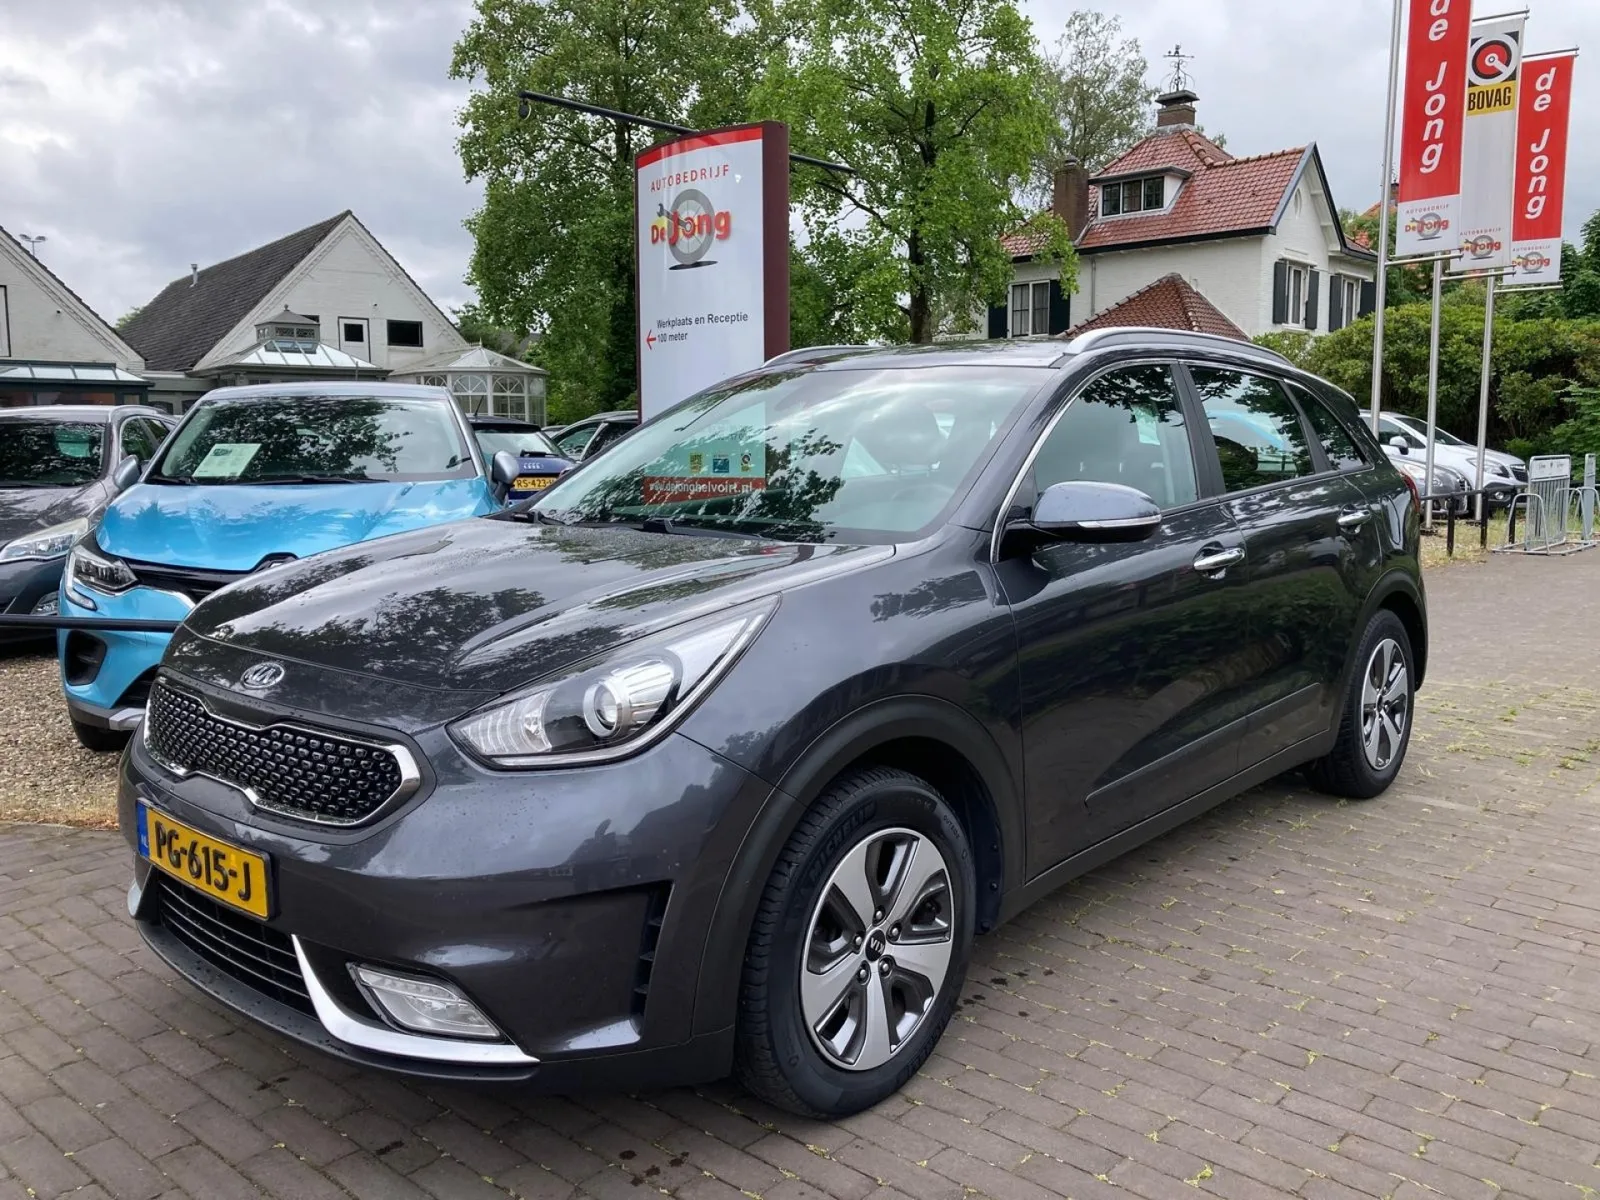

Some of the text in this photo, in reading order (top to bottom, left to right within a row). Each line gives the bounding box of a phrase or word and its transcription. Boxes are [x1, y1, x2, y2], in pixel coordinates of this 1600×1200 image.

[1467, 86, 1512, 111] BOVAG
[1420, 61, 1448, 174] Jong
[1525, 67, 1556, 220] de Jong
[651, 165, 729, 192] AUTOBEDRIJF
[651, 210, 731, 246] De Jong
[656, 312, 749, 329] Werkplaats en Receptie
[657, 332, 688, 342] 100 meter
[154, 820, 251, 901] PG-615-J
